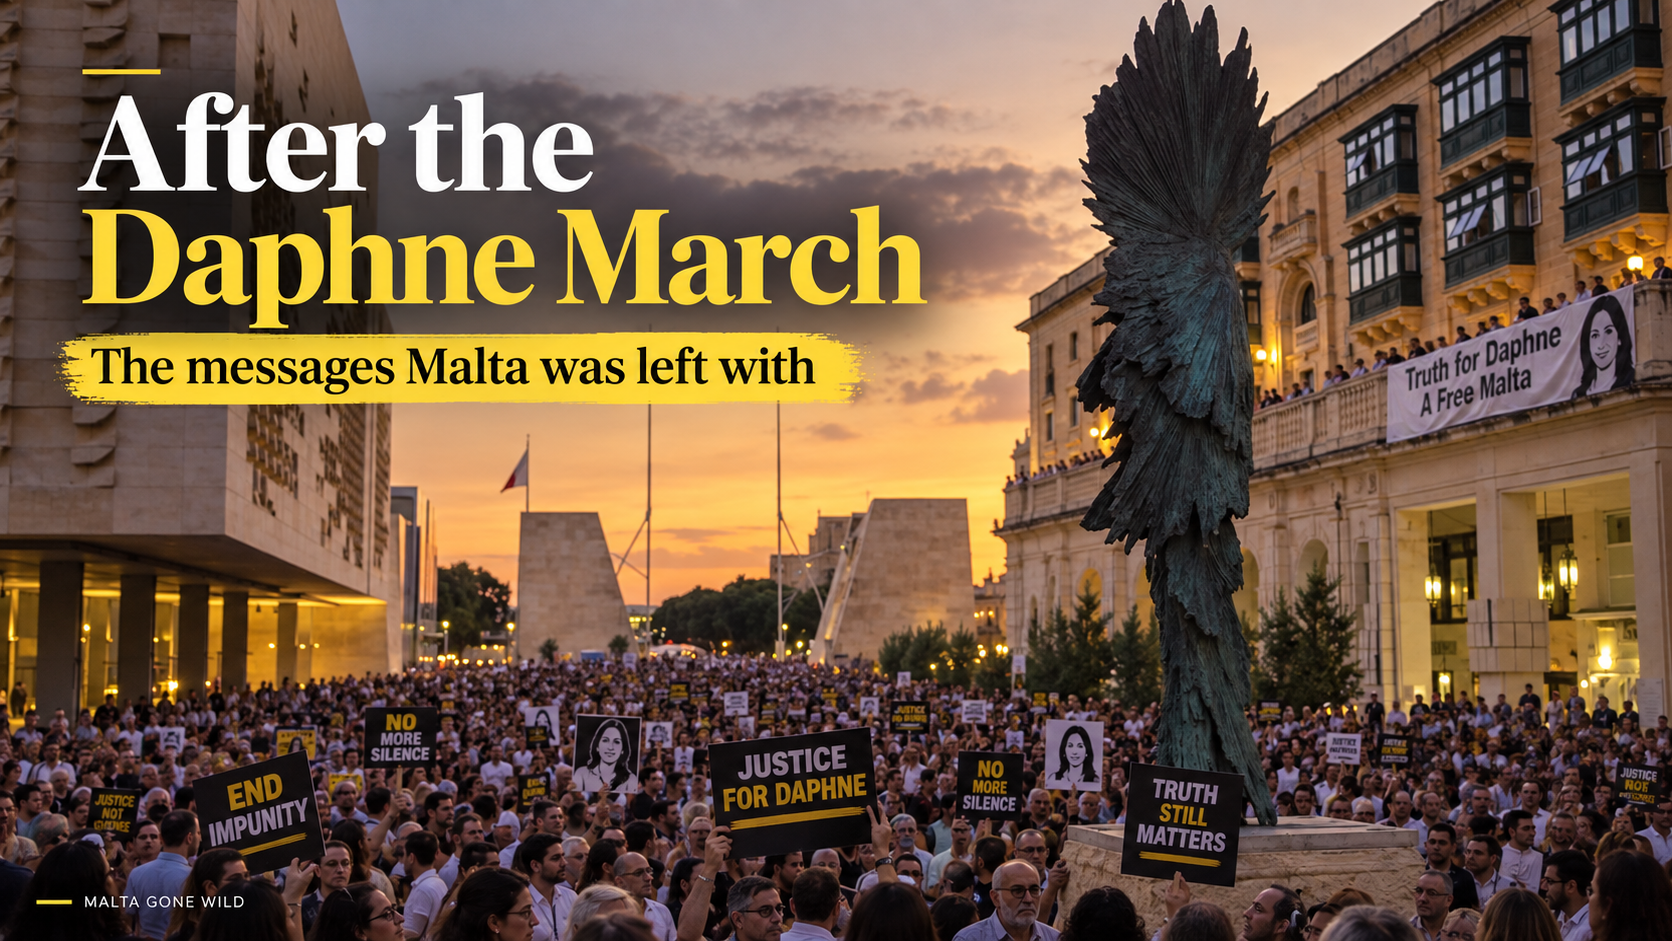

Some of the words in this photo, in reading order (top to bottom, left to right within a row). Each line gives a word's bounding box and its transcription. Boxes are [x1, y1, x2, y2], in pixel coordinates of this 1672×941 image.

[1405, 357, 1449, 391] Truth
[1454, 350, 1481, 377] for
[1485, 325, 1562, 367] Daphne
[1420, 392, 1433, 418] A
[1437, 383, 1475, 412] Free
[1480, 367, 1532, 400] Malta
[385, 713, 417, 731] NO
[380, 731, 422, 746] MORE
[370, 746, 430, 762] SILENCE
[737, 744, 848, 781] JUSTICE
[977, 760, 1005, 779] NO
[1620, 767, 1658, 783] JUSTICE
[226, 773, 283, 812] END
[722, 784, 769, 812] FOR
[775, 773, 868, 806] DAPHNE
[972, 779, 1008, 795] MORE
[1152, 778, 1219, 805] TRUTH
[94, 793, 136, 808] JUSTICE
[962, 794, 1017, 812] SILENCE
[101, 807, 125, 820] NOT
[208, 797, 308, 847] IMPUNITY
[1159, 803, 1208, 827] STILL
[1136, 823, 1227, 853] MATTERS
